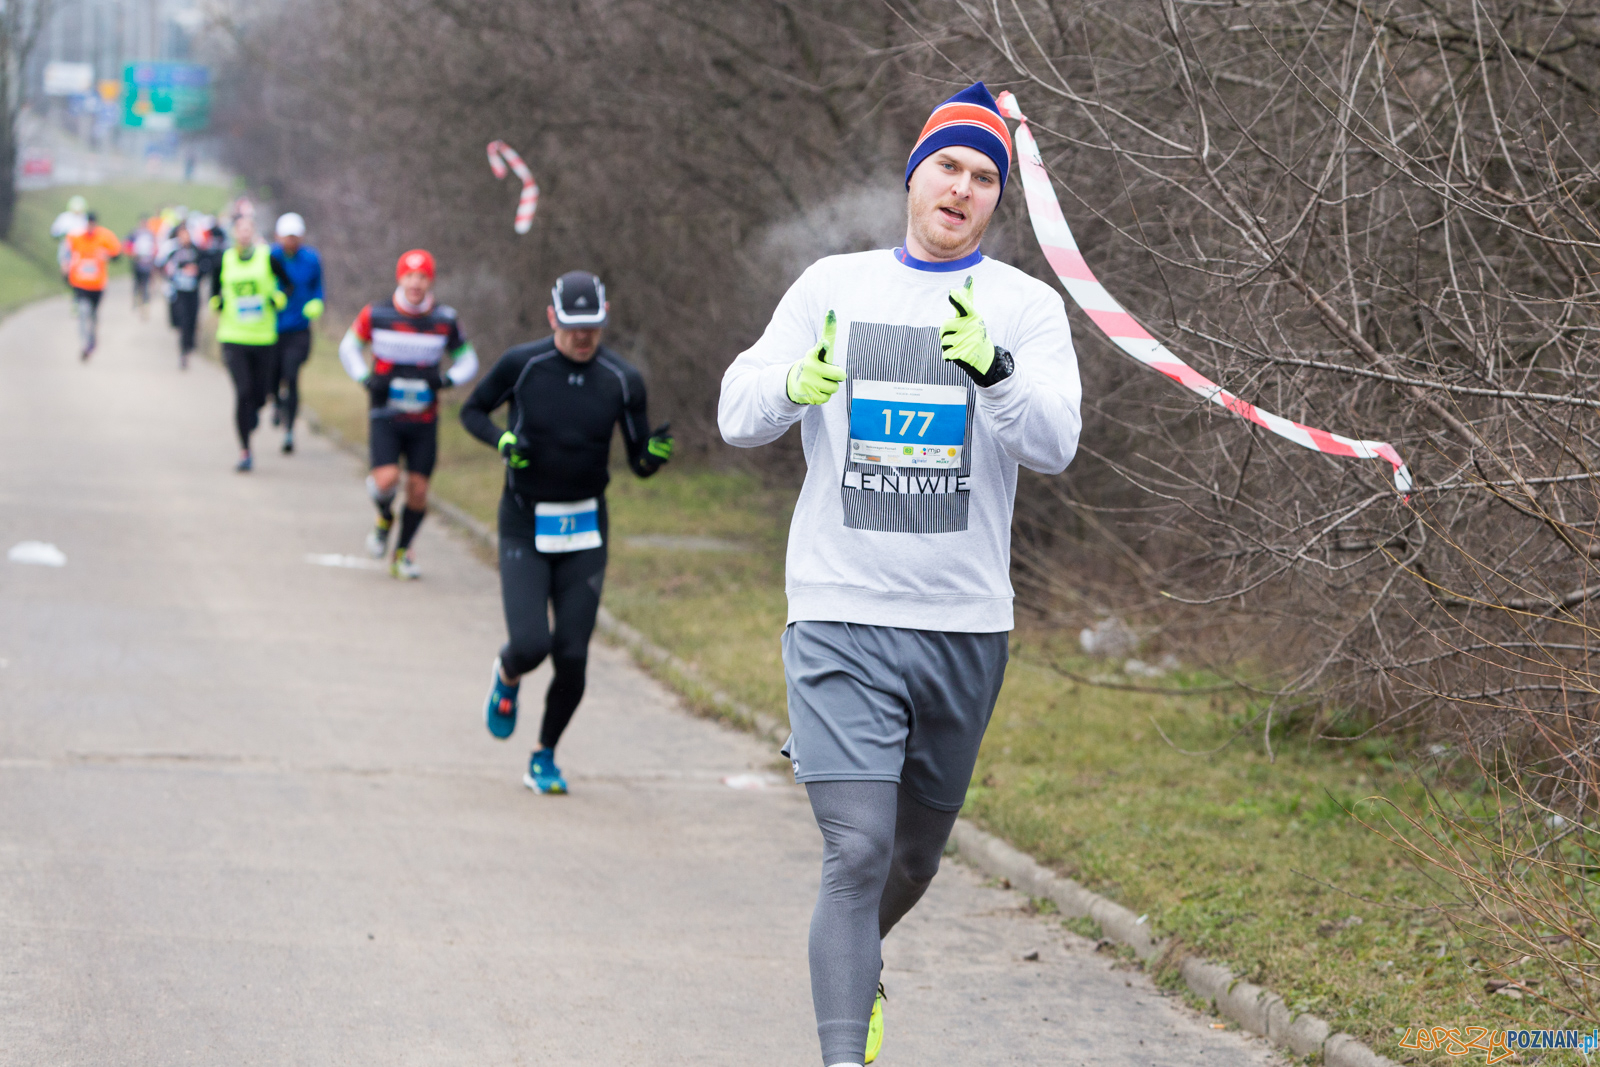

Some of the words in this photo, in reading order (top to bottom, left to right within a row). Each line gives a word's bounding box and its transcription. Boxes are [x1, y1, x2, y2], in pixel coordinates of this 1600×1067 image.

[881, 409, 935, 437] 177
[842, 471, 971, 494] LENIWIE
[559, 516, 576, 533] 71
